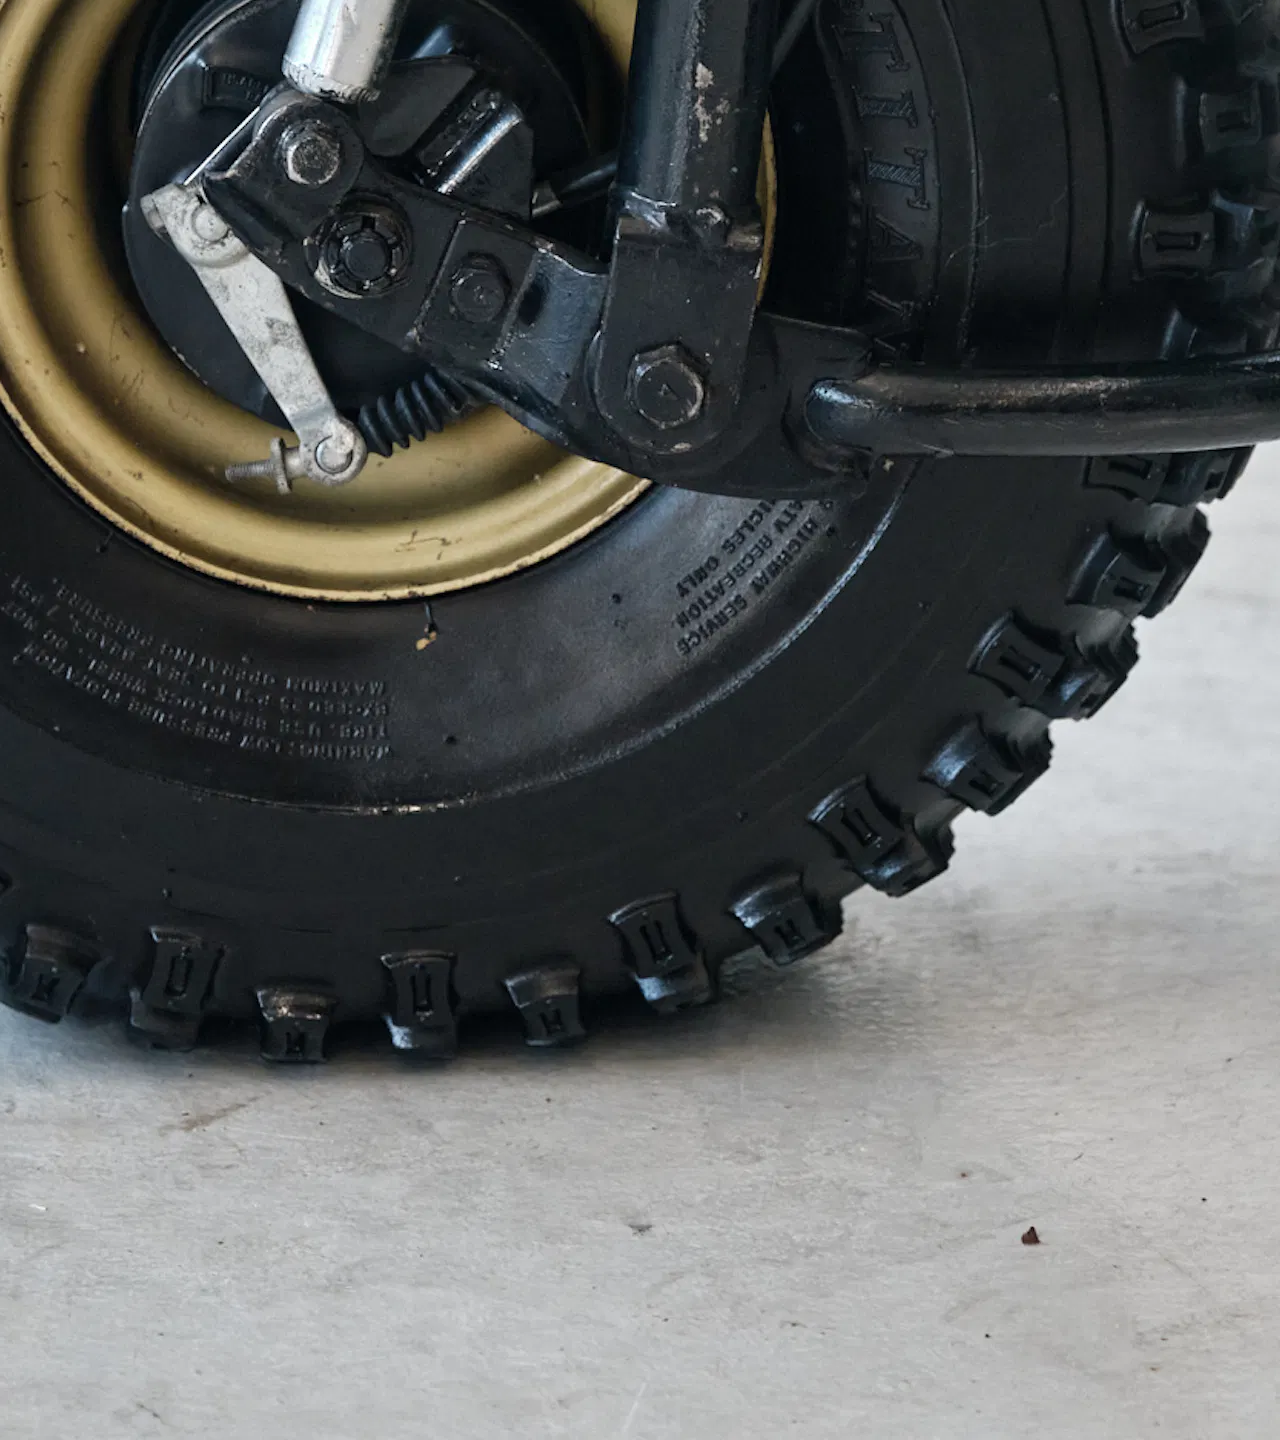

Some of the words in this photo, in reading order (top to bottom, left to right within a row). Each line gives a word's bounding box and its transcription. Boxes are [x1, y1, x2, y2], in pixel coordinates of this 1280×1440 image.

[773, 498, 803, 534] ATV
[674, 534, 773, 630] RECREATION
[675, 554, 719, 598] ONLY
[749, 518, 818, 596] HIGHWAY
[675, 595, 748, 656] SERVICE
